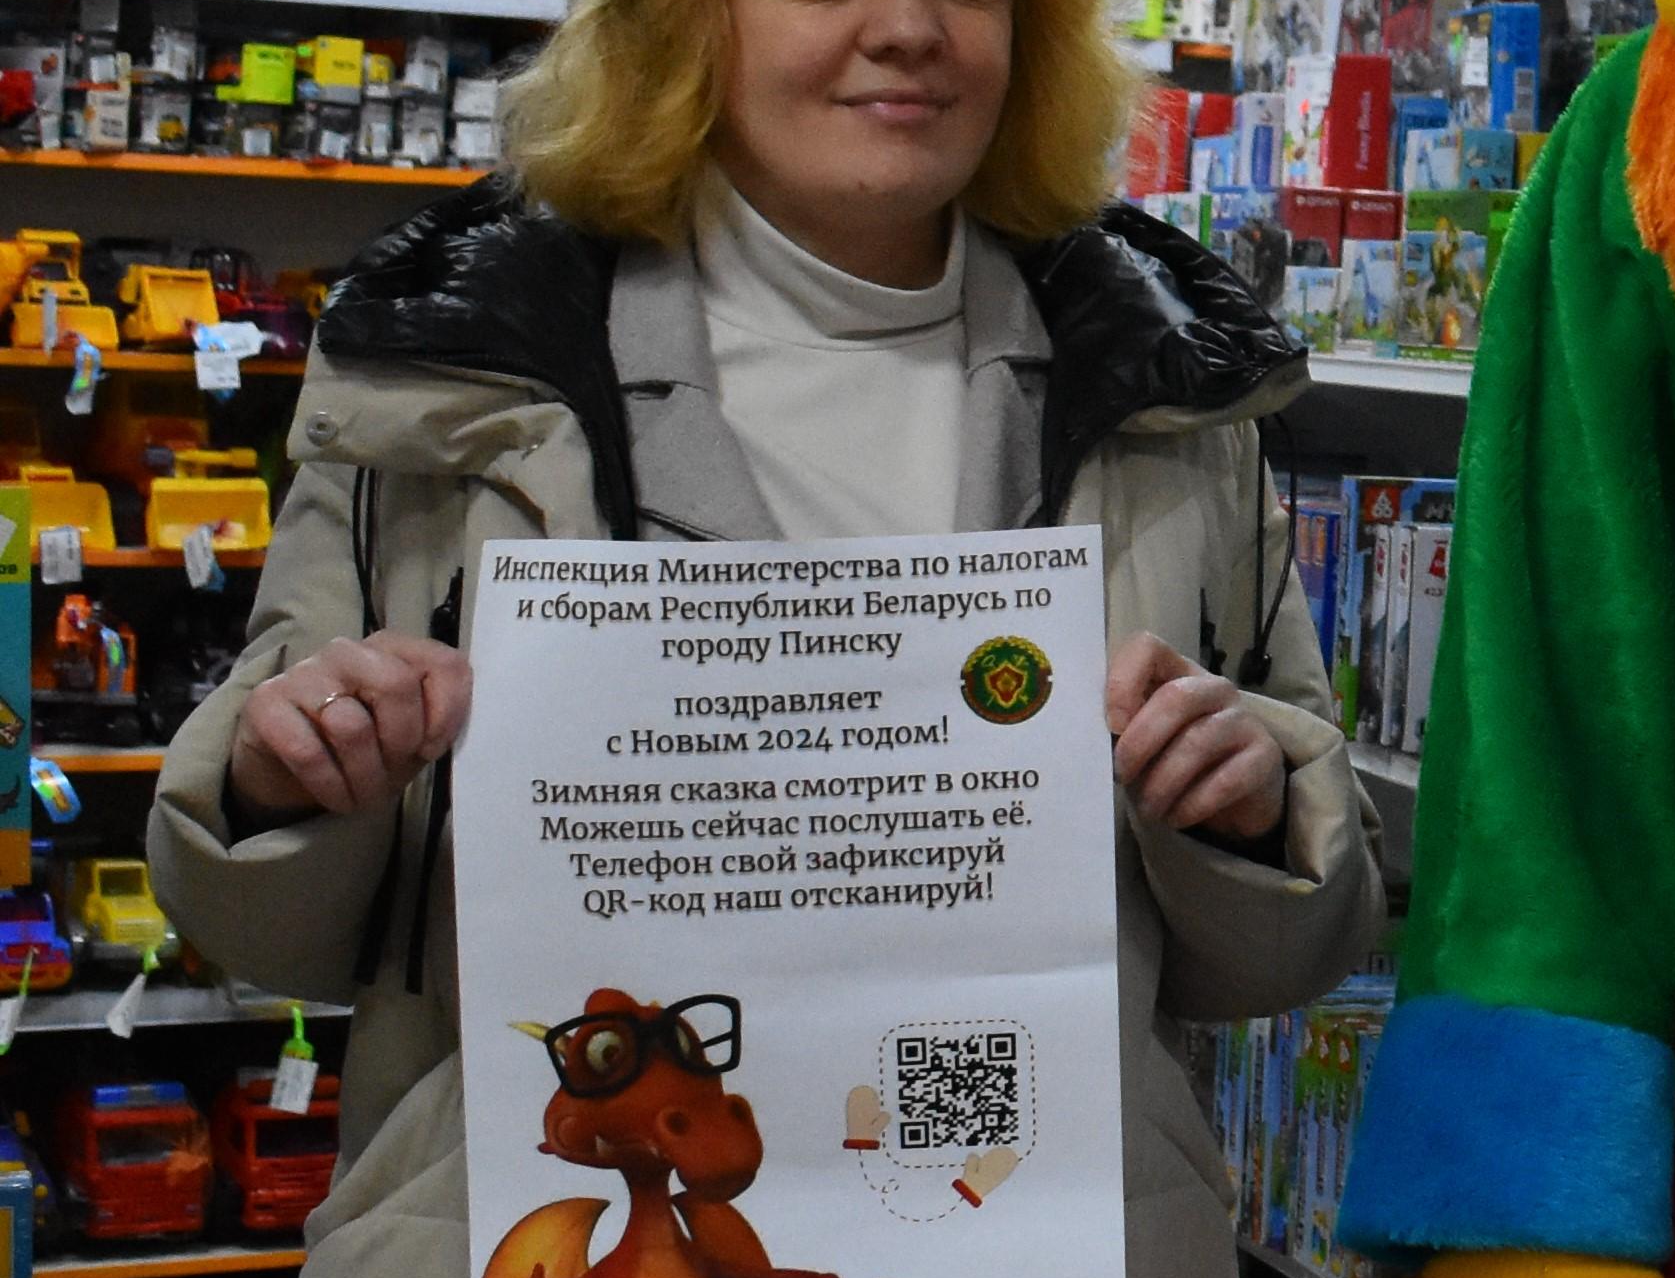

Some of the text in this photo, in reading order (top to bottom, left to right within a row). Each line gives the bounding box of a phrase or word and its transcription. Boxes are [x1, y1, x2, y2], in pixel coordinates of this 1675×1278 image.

[492, 547, 1089, 589] Инспекция Министерства по налогам
[516, 587, 1052, 630] и сборам Республики Беларусь по
[660, 630, 903, 666] городу Пинску
[673, 690, 883, 722] поздравляет
[605, 714, 949, 757] с Новым 2024 годом!
[530, 769, 1040, 806] Зимняя сказка смотрит в окно
[539, 799, 1033, 843] Можешь сейчас послушать её.
[568, 836, 1006, 884] Телефон свой зафиксируй
[582, 871, 994, 918] QR-код наш отсканируй!
